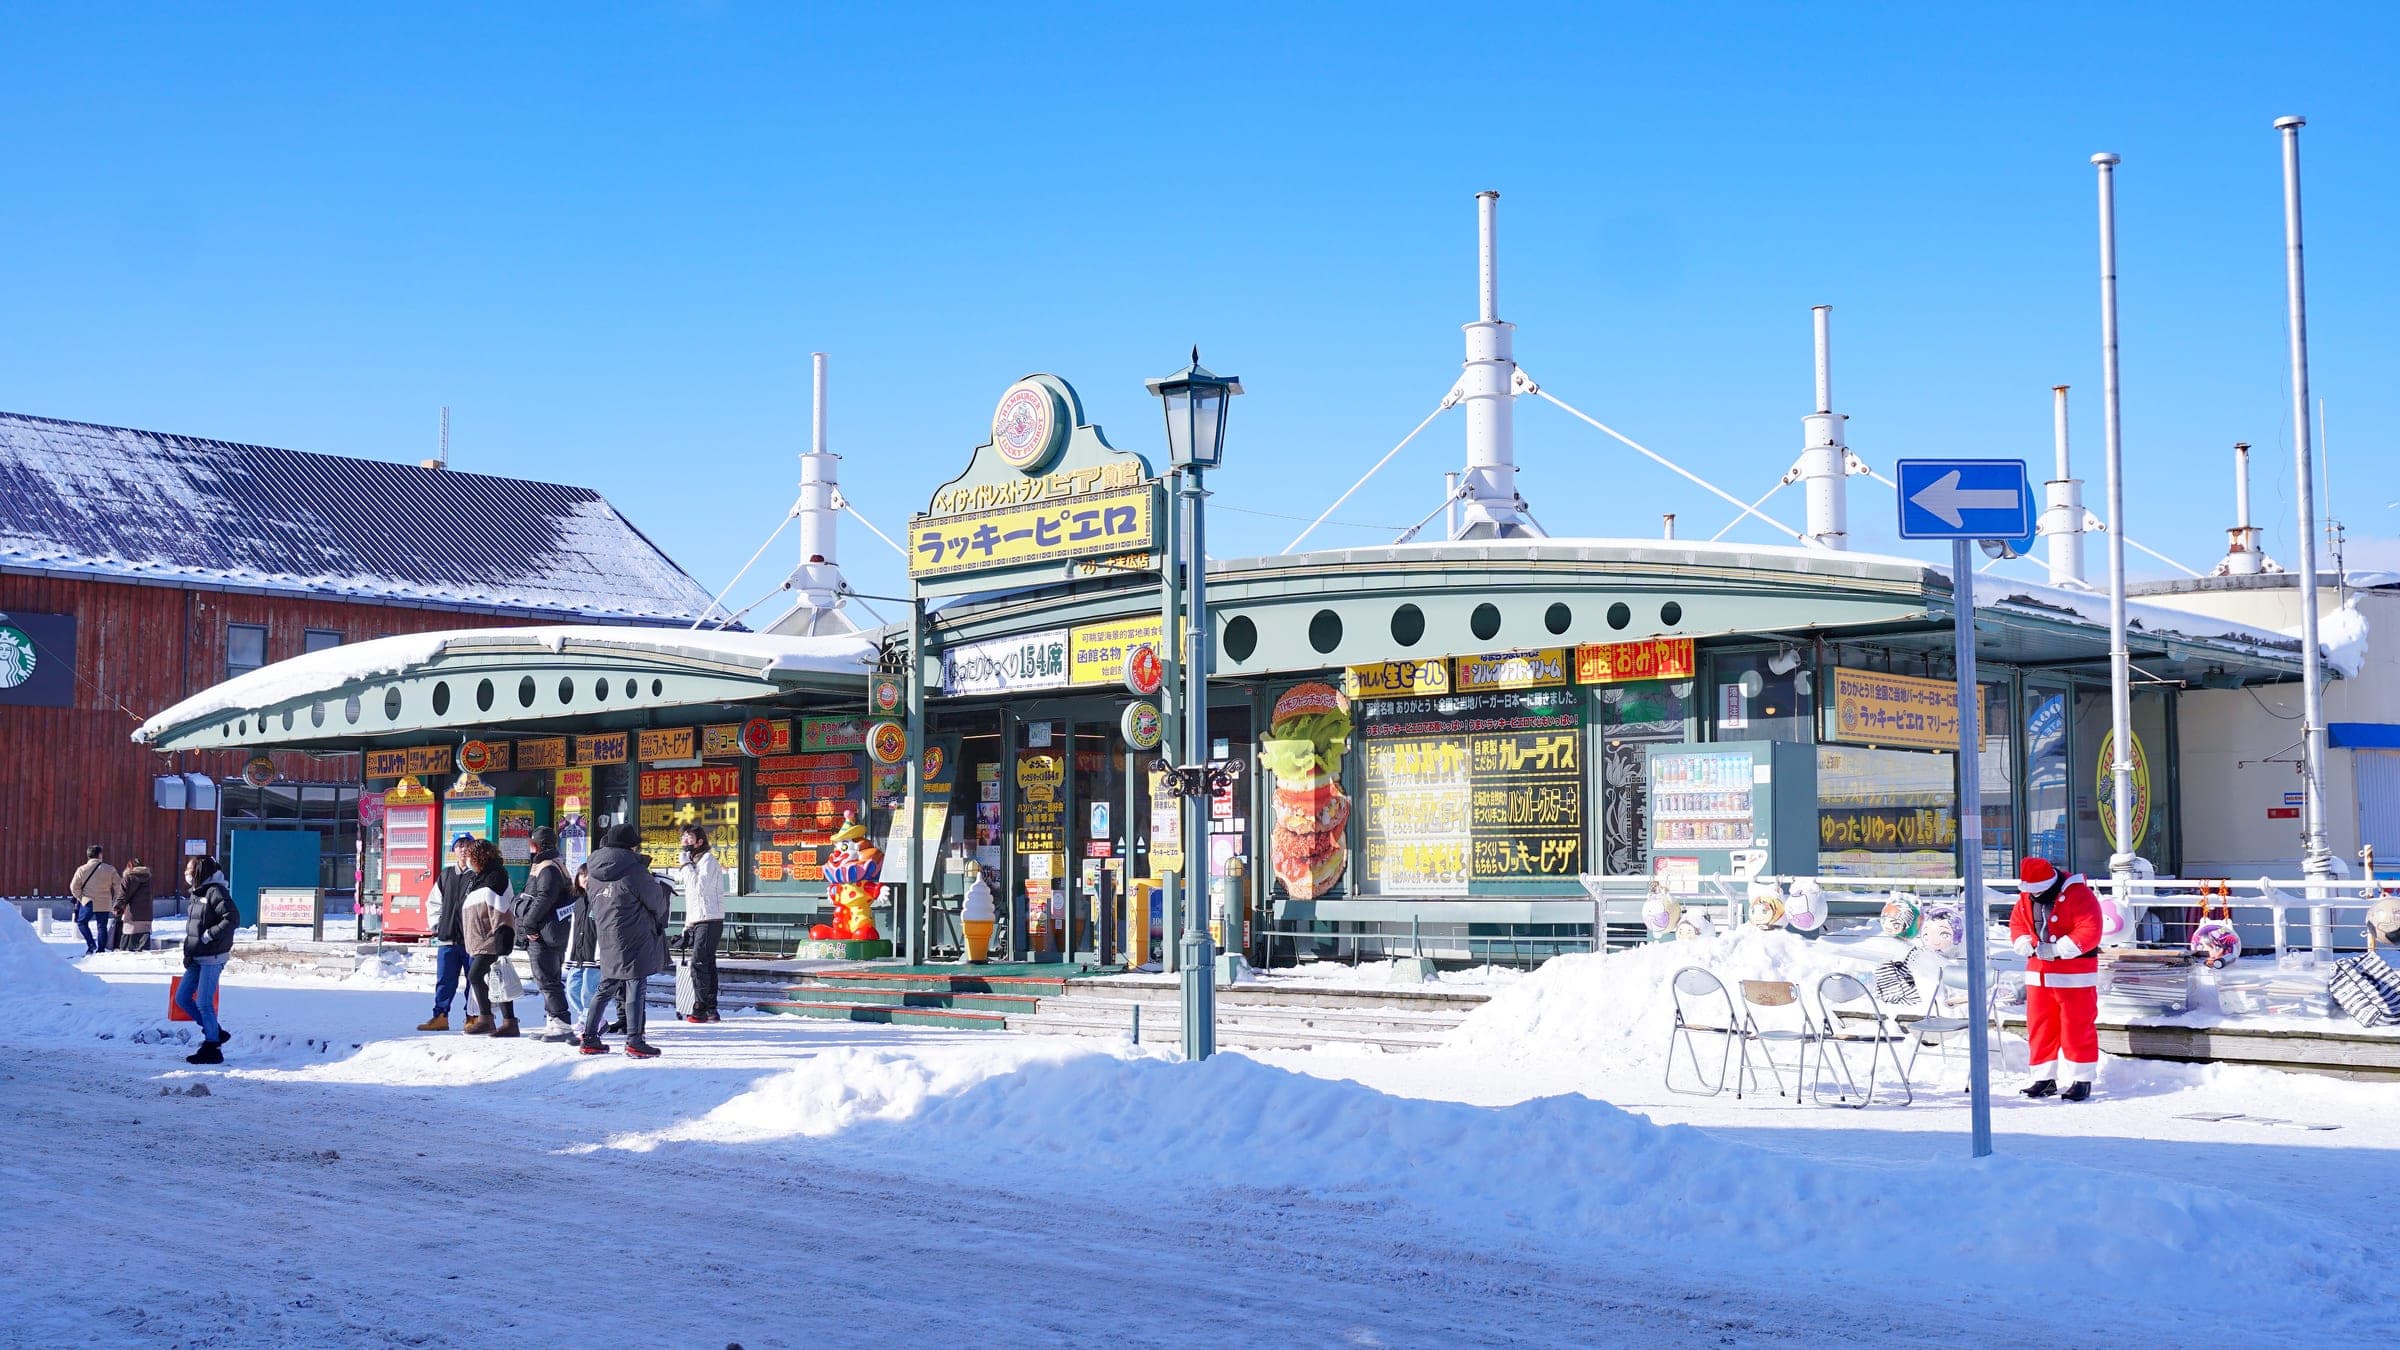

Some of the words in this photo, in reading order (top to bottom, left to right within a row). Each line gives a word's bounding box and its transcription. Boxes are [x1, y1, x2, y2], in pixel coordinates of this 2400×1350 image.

[935, 478, 1044, 513] ベイサイドレストラン
[918, 505, 1138, 563] ラッキーピエロ
[1077, 646, 1121, 664] 函館名物
[1580, 638, 1690, 676] 函館おみやげ
[1859, 705, 1925, 731] ラッキーピエロ
[1499, 735, 1576, 771] カレーライス
[641, 771, 738, 797] 函館おみやげ
[1214, 802, 1232, 814] OK
[1507, 786, 1577, 823] ハンバーグステーキ
[1498, 839, 1577, 874] ラッキーピザ
